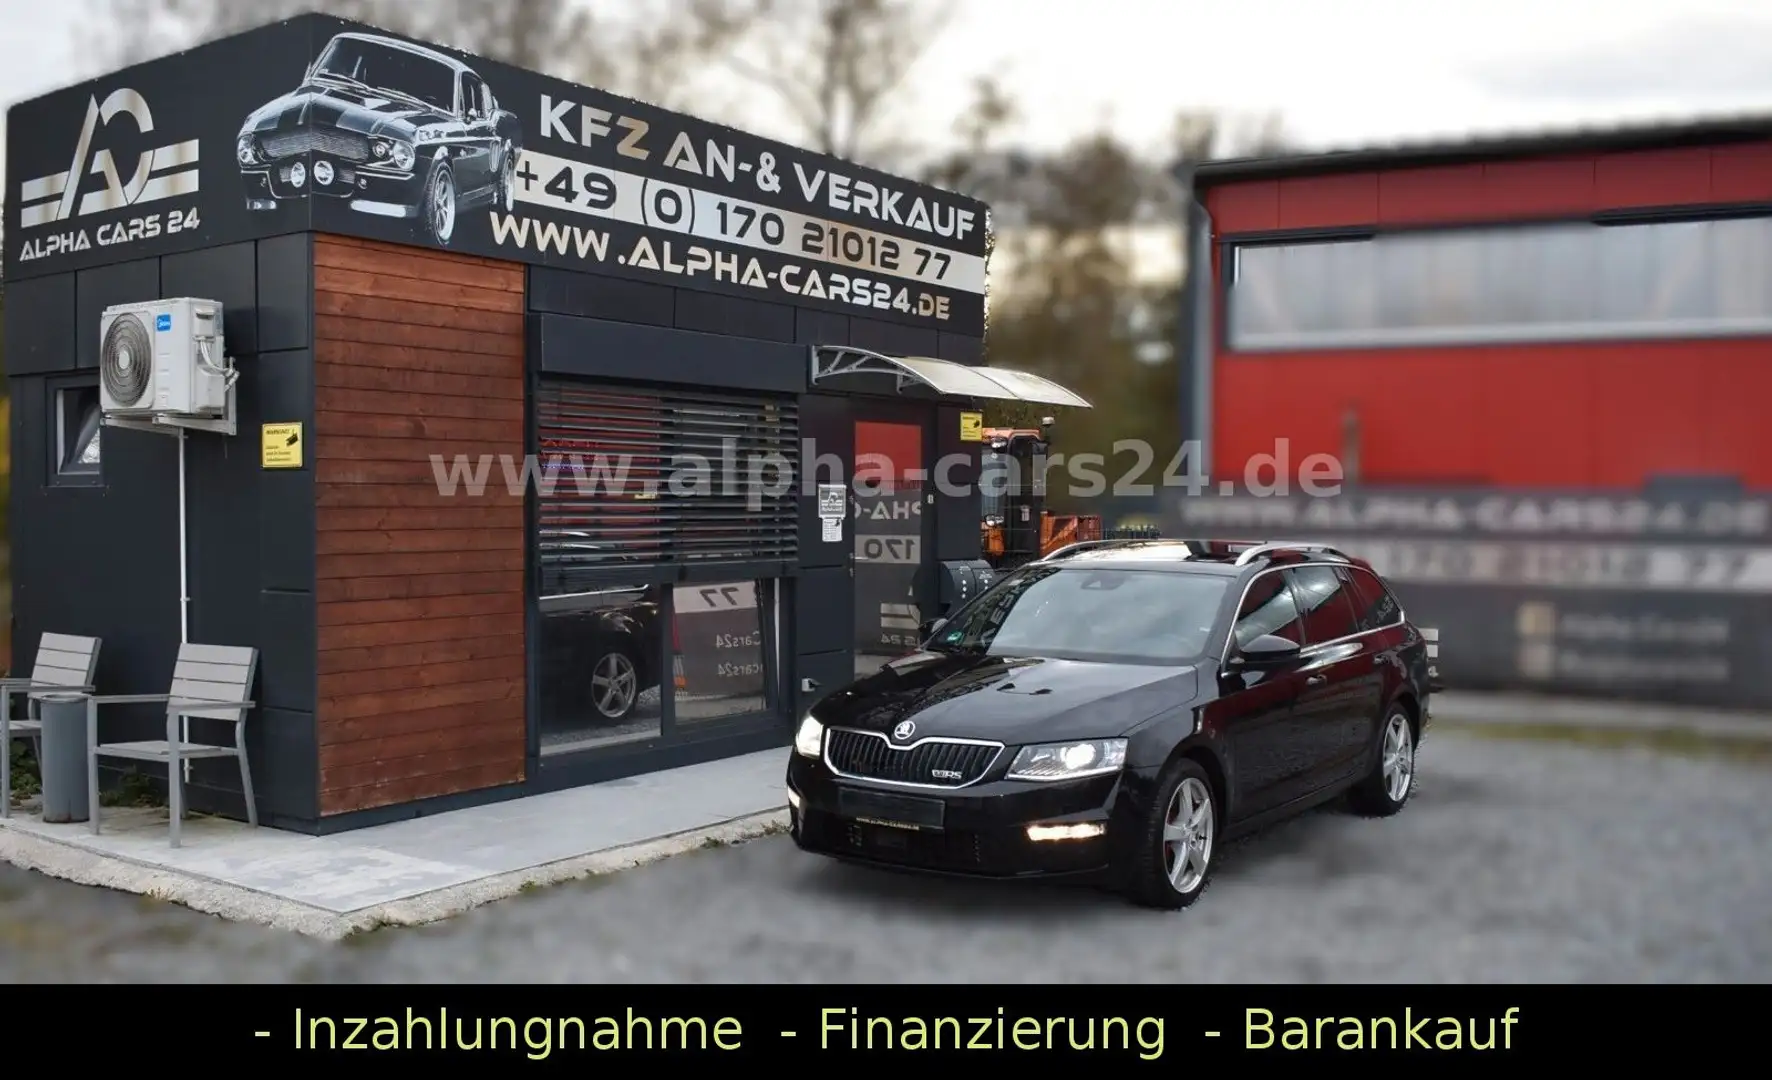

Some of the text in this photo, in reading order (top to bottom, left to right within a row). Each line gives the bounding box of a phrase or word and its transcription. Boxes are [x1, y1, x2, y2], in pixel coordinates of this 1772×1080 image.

[516, 160, 951, 281] +49 (0) 170 21012 77
[540, 95, 650, 160] KFZ
[793, 162, 976, 240] VERKAUF
[19, 207, 200, 262] ALPHA CARS 24
